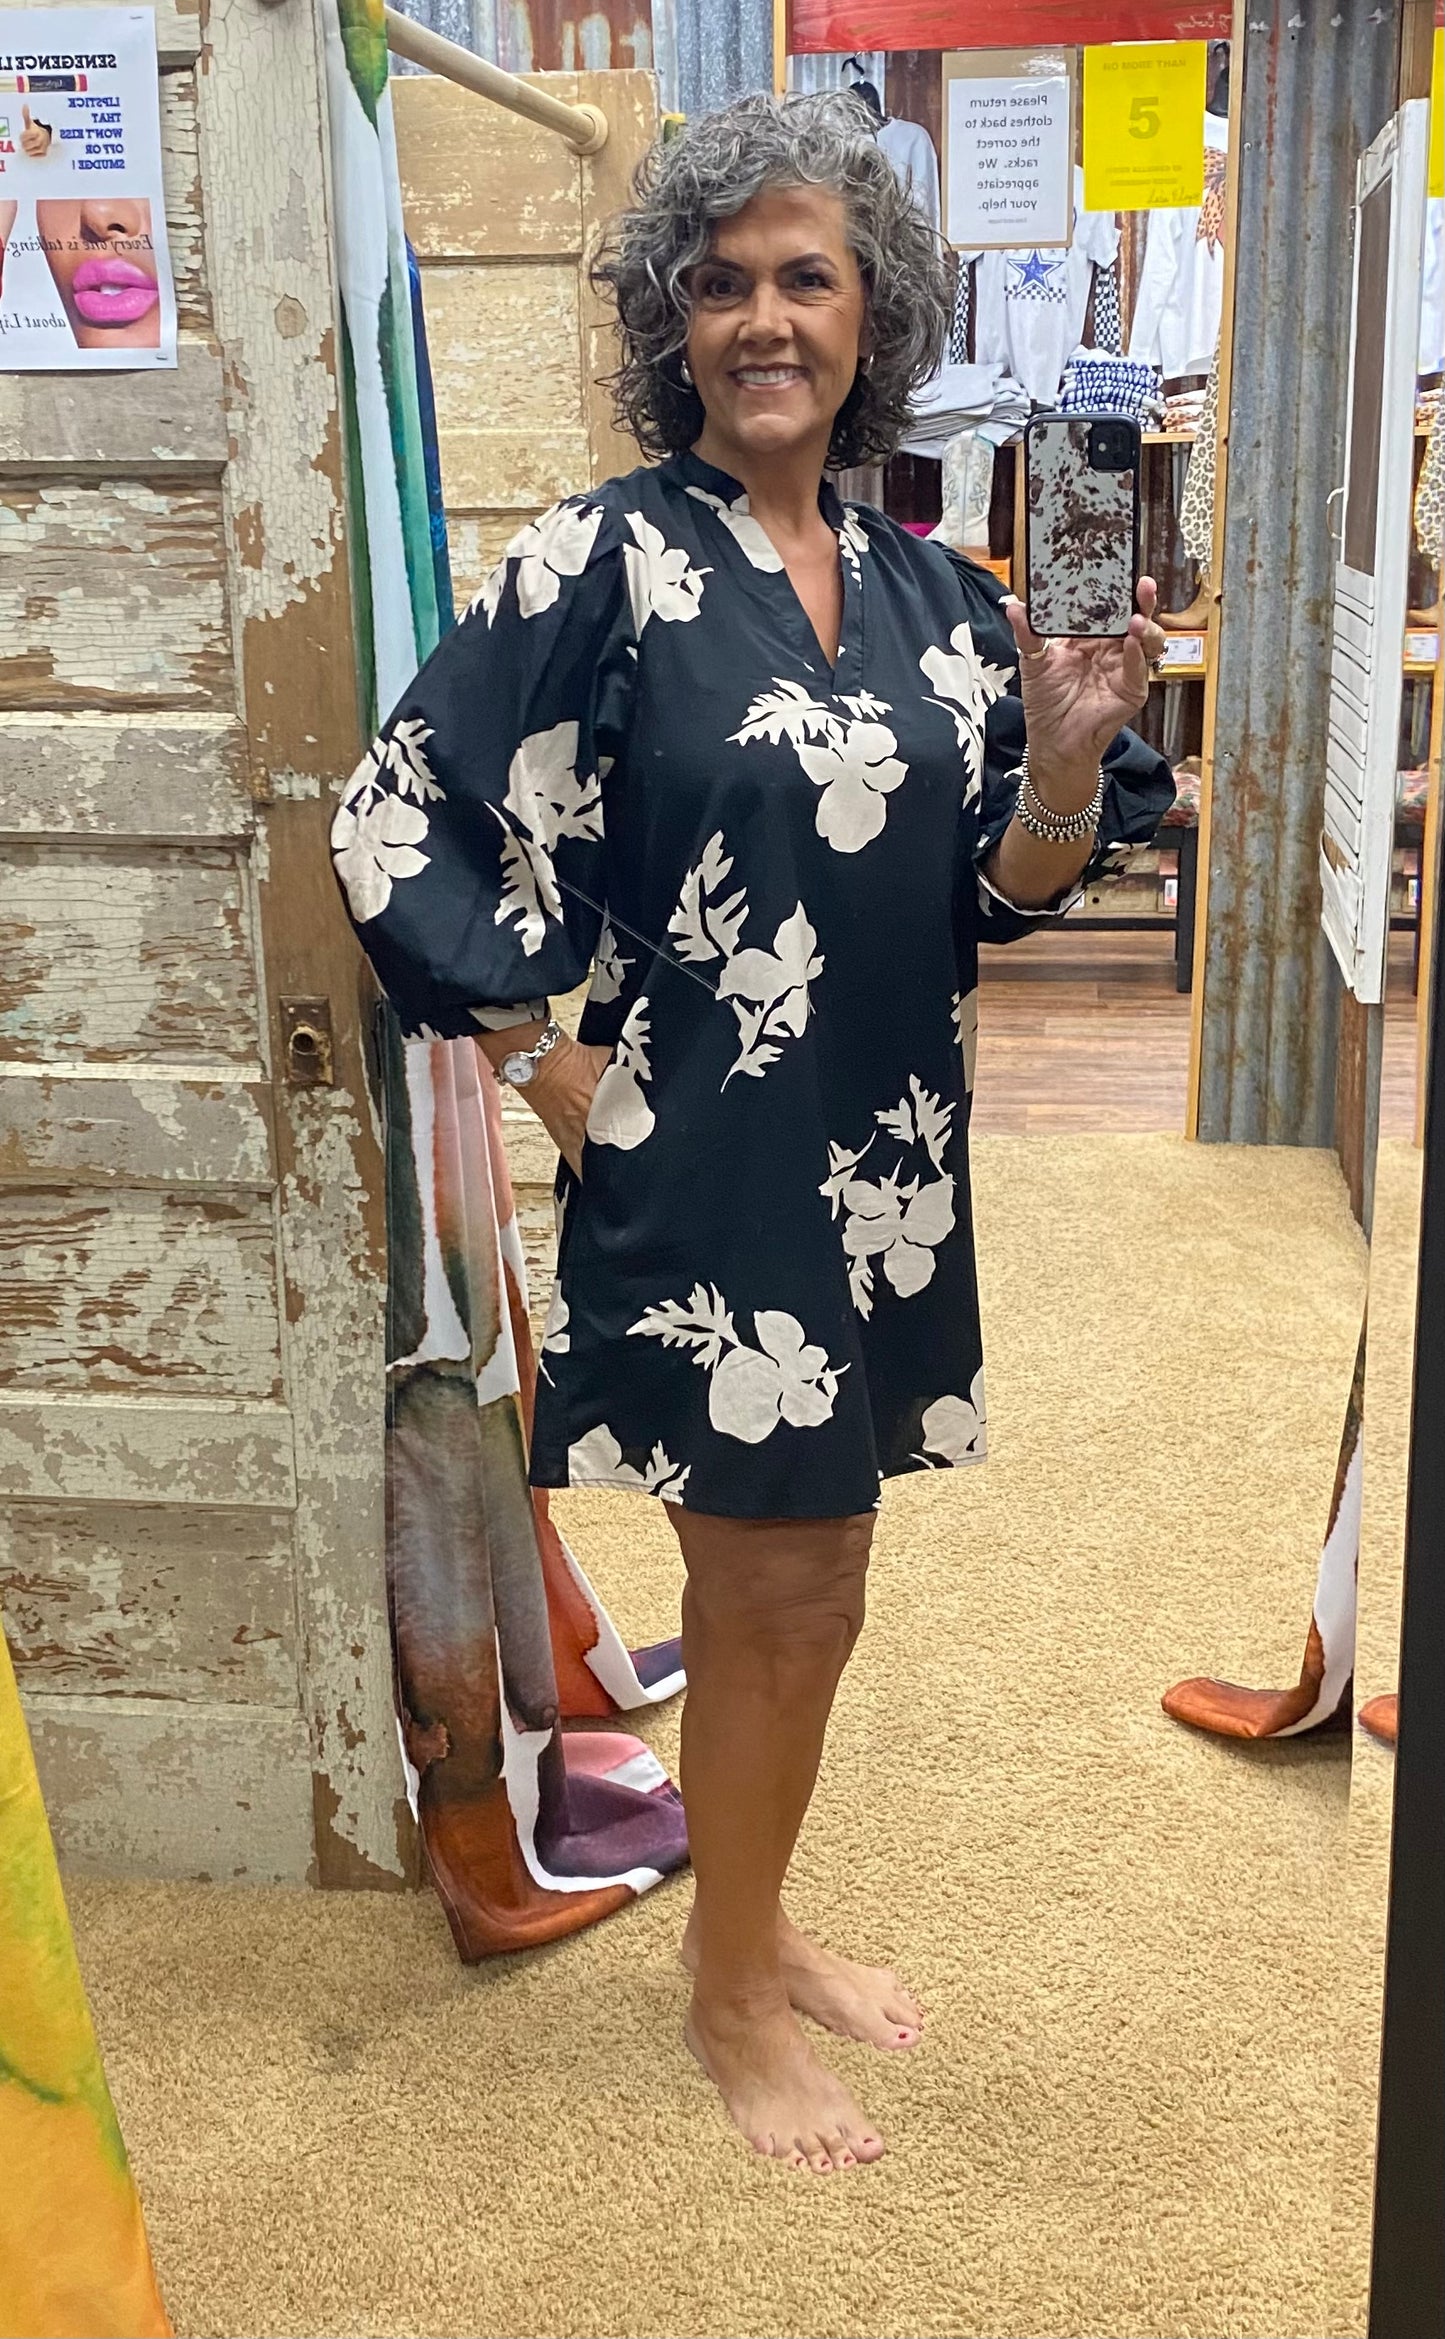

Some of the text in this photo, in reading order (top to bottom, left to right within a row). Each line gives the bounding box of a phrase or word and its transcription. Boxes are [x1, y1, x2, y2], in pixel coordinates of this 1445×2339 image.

[1103, 59, 1186, 70] NO MORE THAN
[1128, 96, 1161, 139] 5
